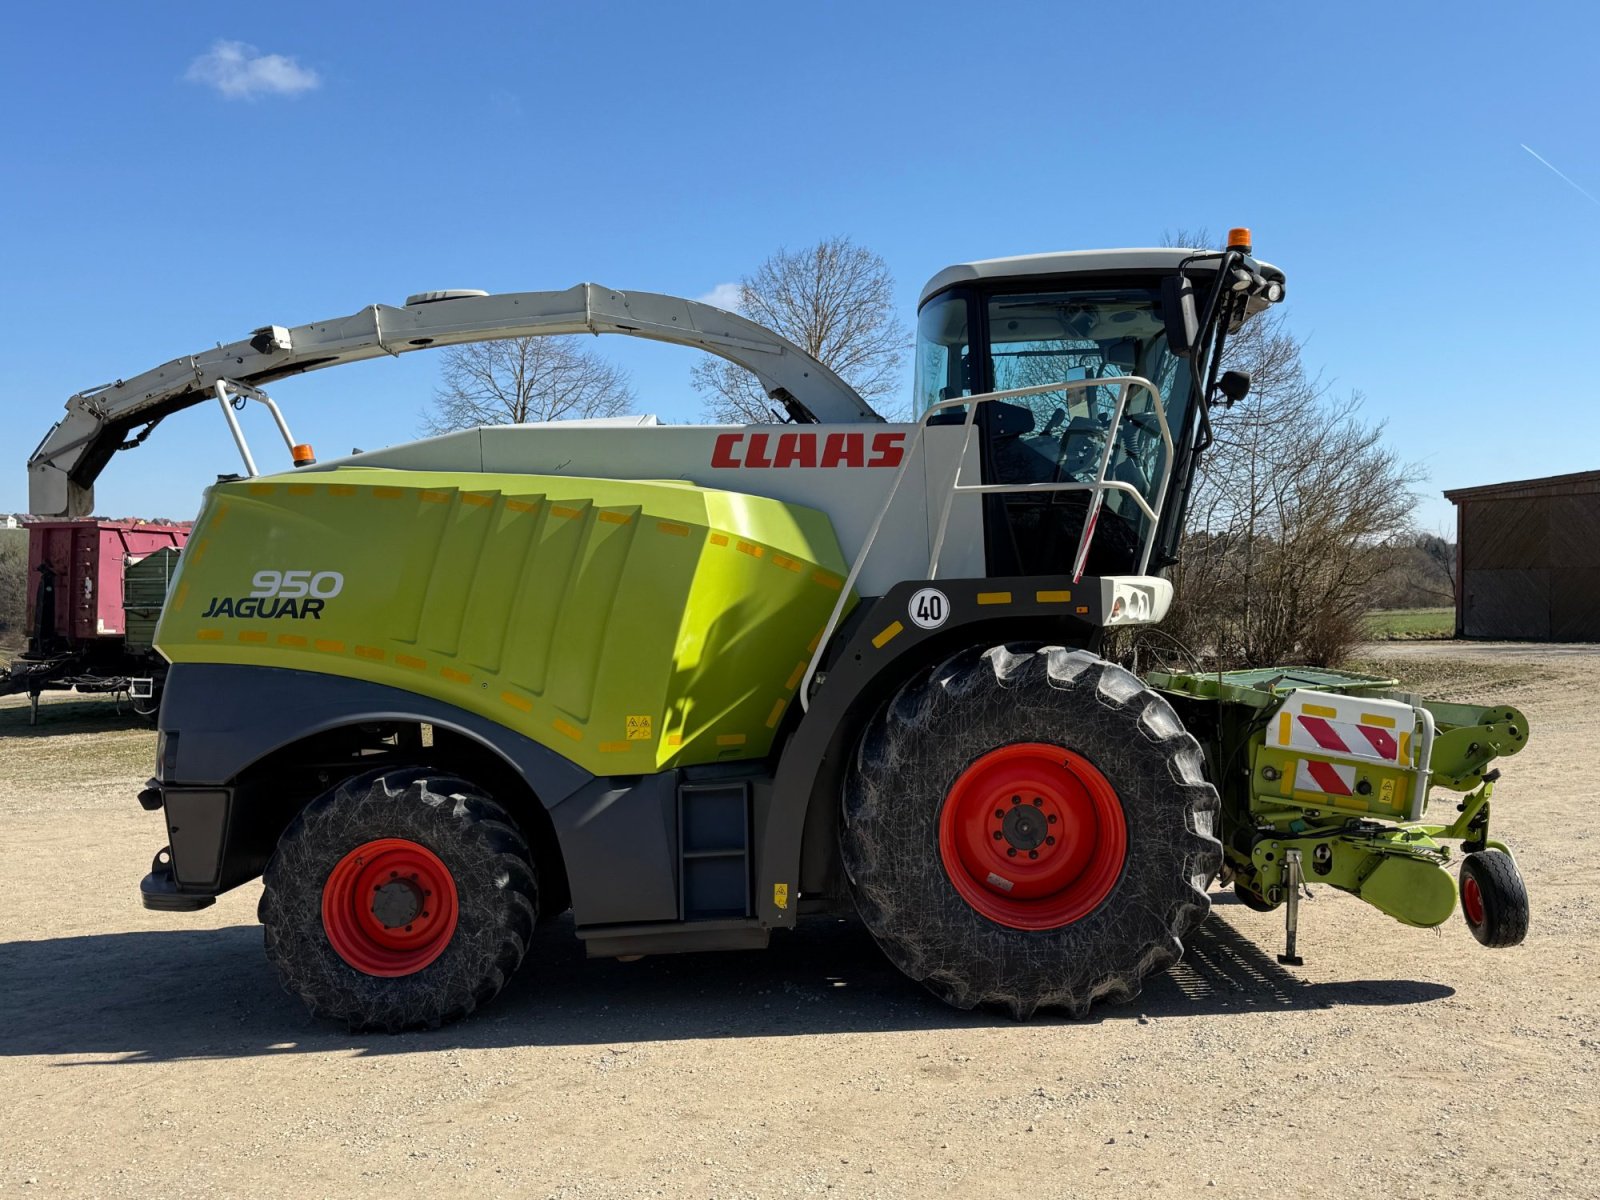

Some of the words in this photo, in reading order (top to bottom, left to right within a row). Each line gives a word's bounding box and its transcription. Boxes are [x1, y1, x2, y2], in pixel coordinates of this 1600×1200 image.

[711, 433, 906, 468] CLAAS
[250, 570, 345, 599] 950
[201, 597, 325, 619] JAGUAR
[917, 595, 942, 621] 40
